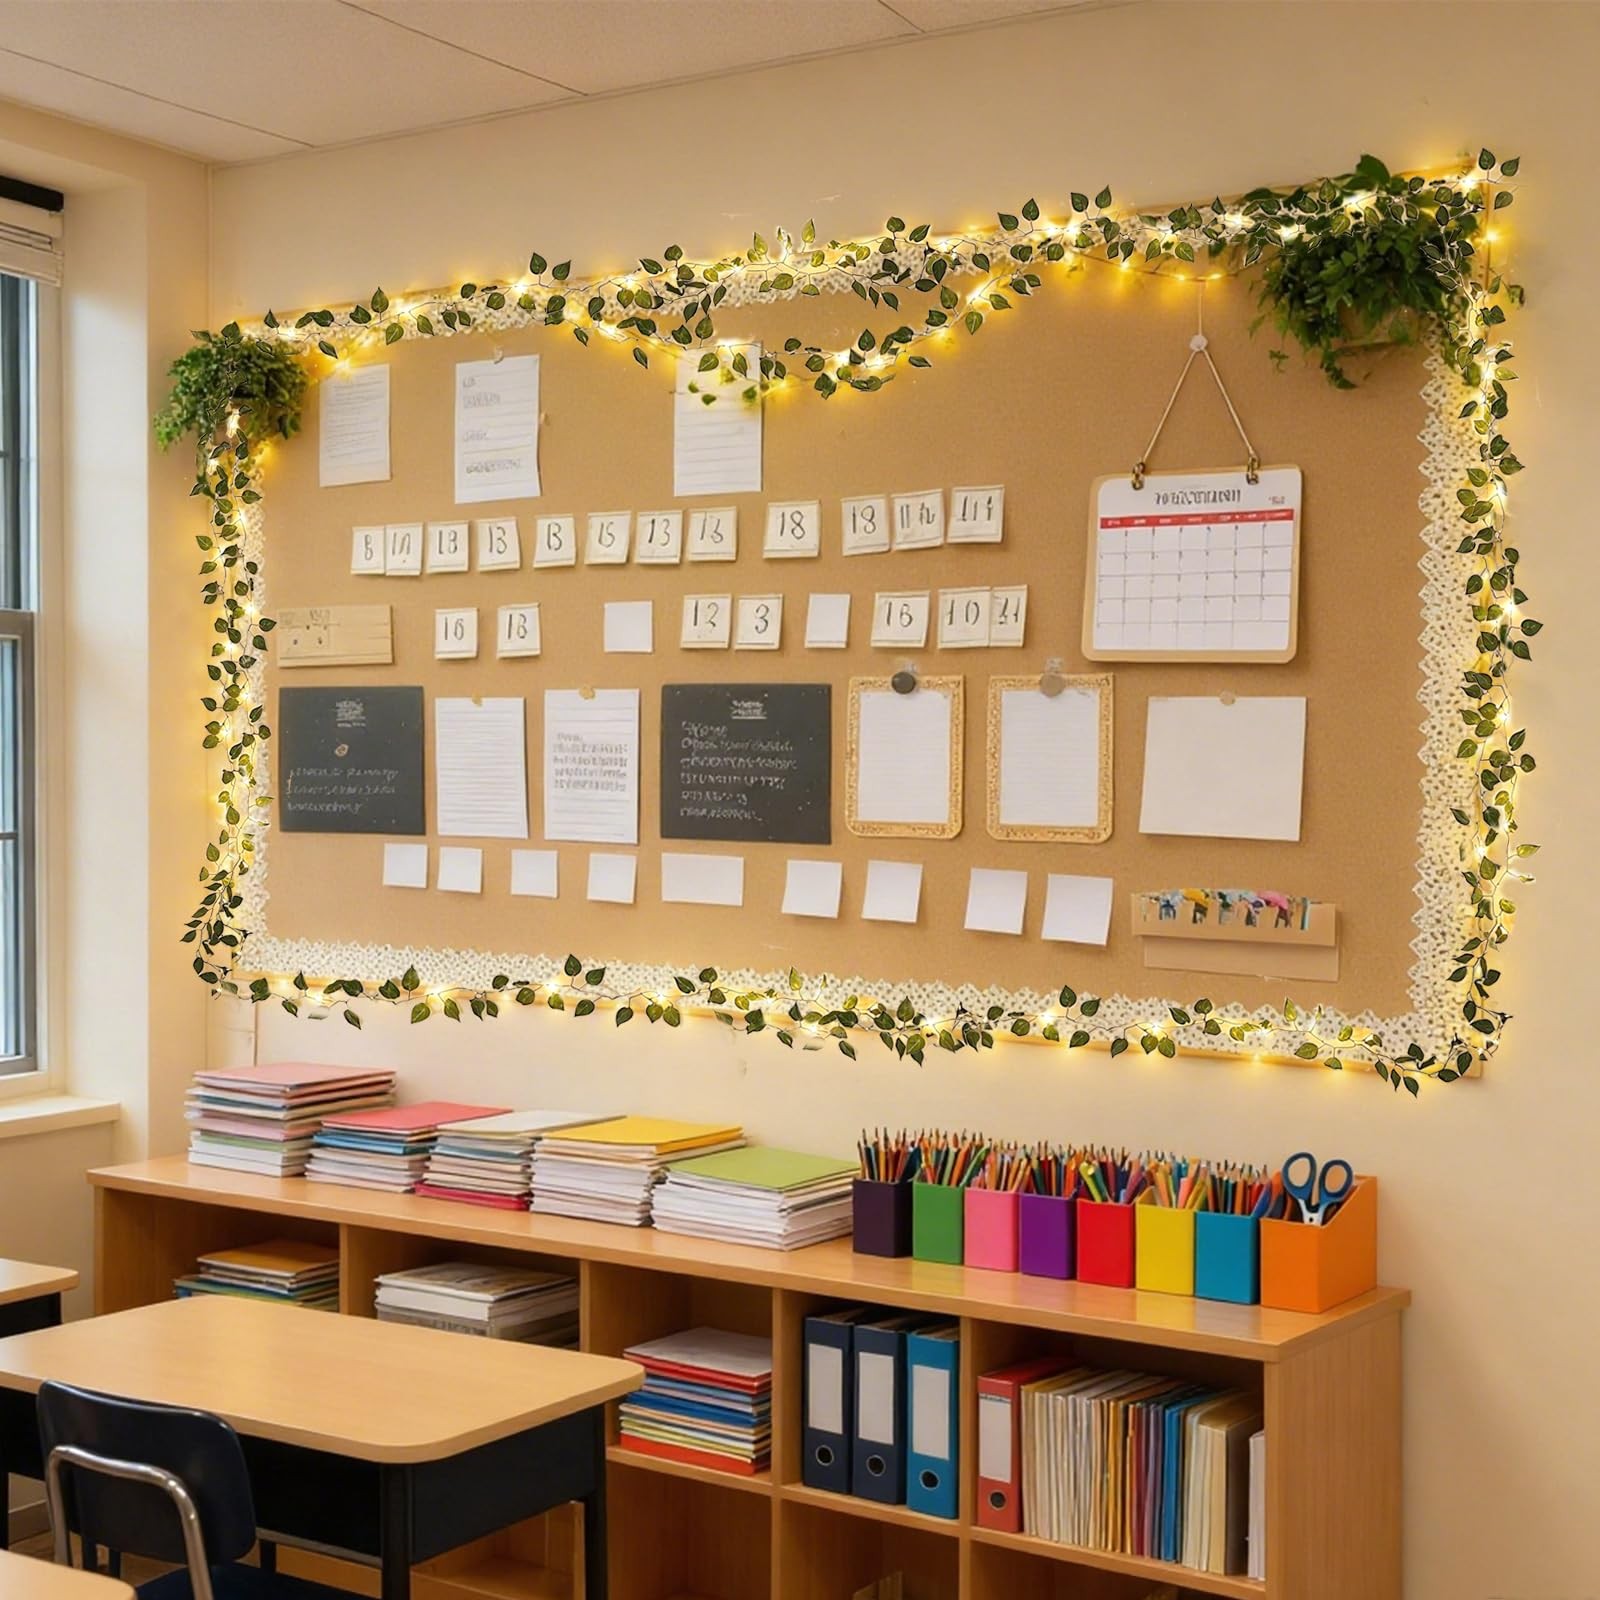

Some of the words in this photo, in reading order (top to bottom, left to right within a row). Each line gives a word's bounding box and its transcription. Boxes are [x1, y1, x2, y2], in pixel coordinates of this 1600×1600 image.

[647, 517, 671, 547] 13
[779, 509, 806, 540] 18
[851, 504, 877, 535] 18
[487, 525, 508, 555] 13
[753, 602, 771, 635] 3
